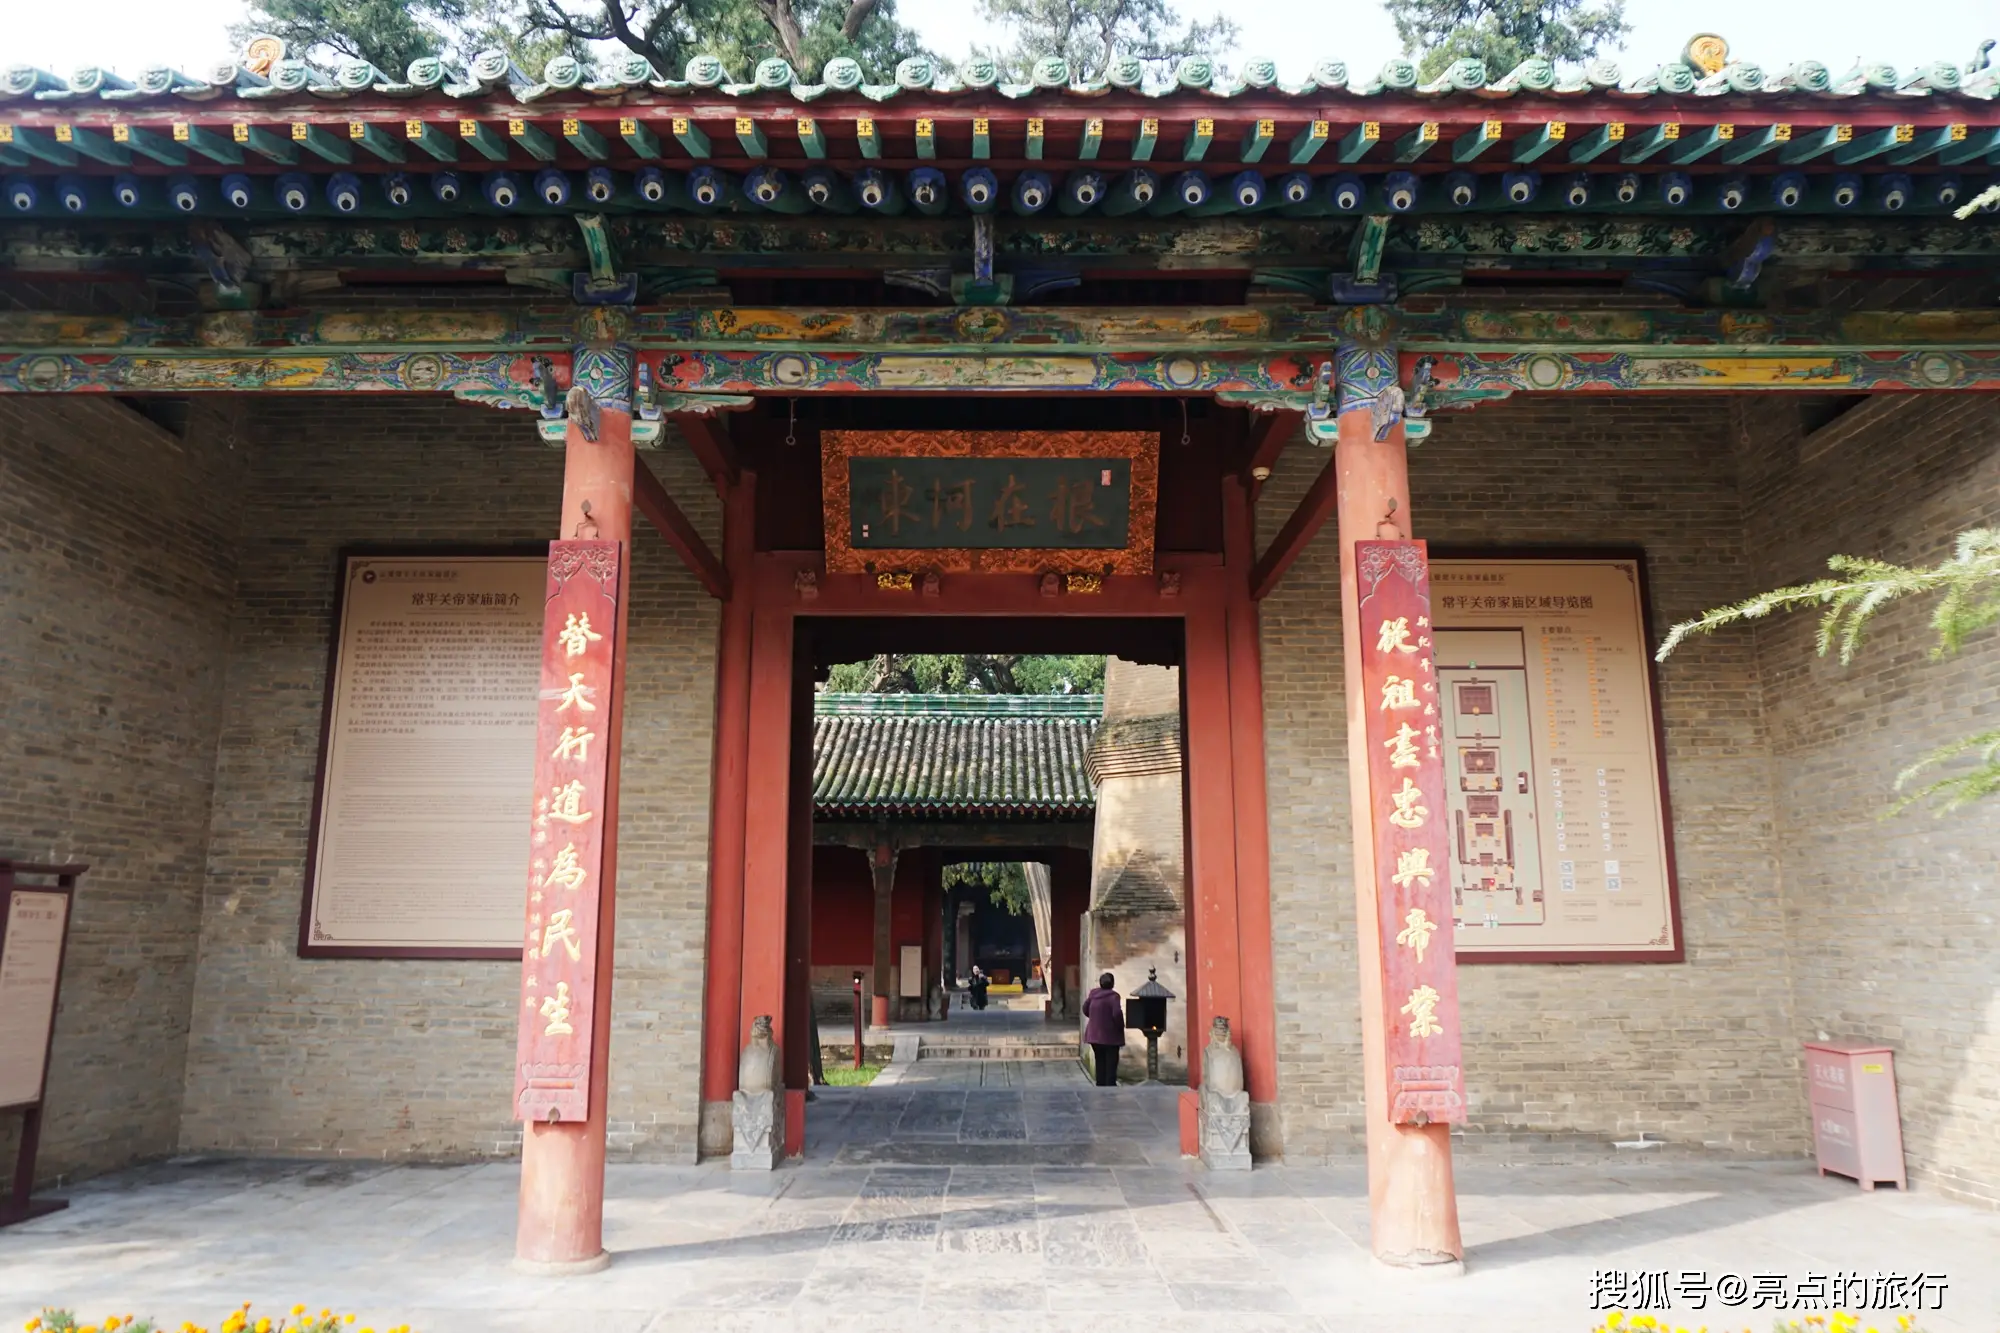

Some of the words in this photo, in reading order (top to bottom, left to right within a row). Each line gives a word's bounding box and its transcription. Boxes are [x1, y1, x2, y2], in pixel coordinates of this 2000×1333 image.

[411, 592, 521, 606] 常平关帝家庙简介
[1442, 595, 1594, 609] 常平关帝家庙区域导览图
